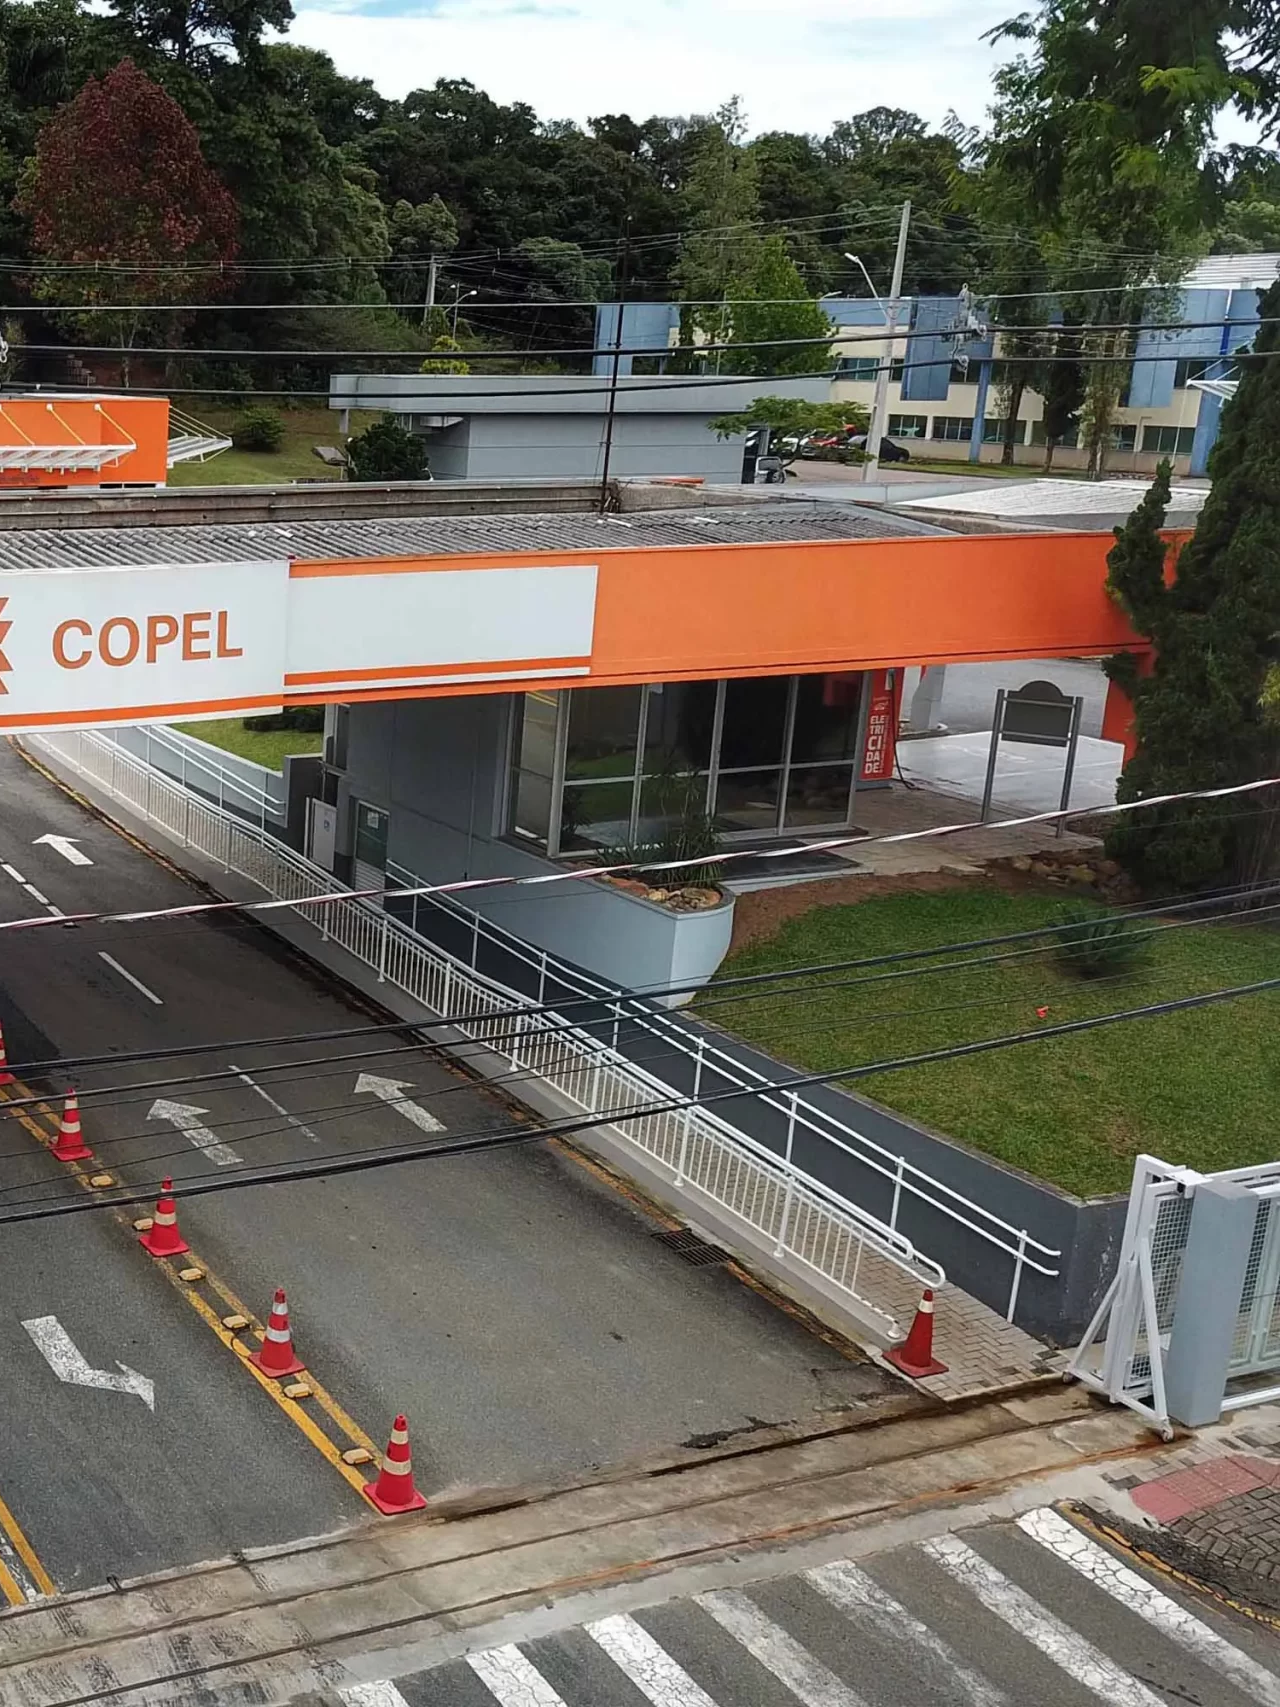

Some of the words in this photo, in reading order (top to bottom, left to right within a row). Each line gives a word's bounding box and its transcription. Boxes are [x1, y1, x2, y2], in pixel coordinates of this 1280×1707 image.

[52, 610, 243, 669] COPEL
[870, 715, 885, 725] ELE
[869, 725, 884, 735] TRI
[867, 735, 882, 750] CI
[865, 751, 881, 762] DA
[864, 762, 881, 774] DE
